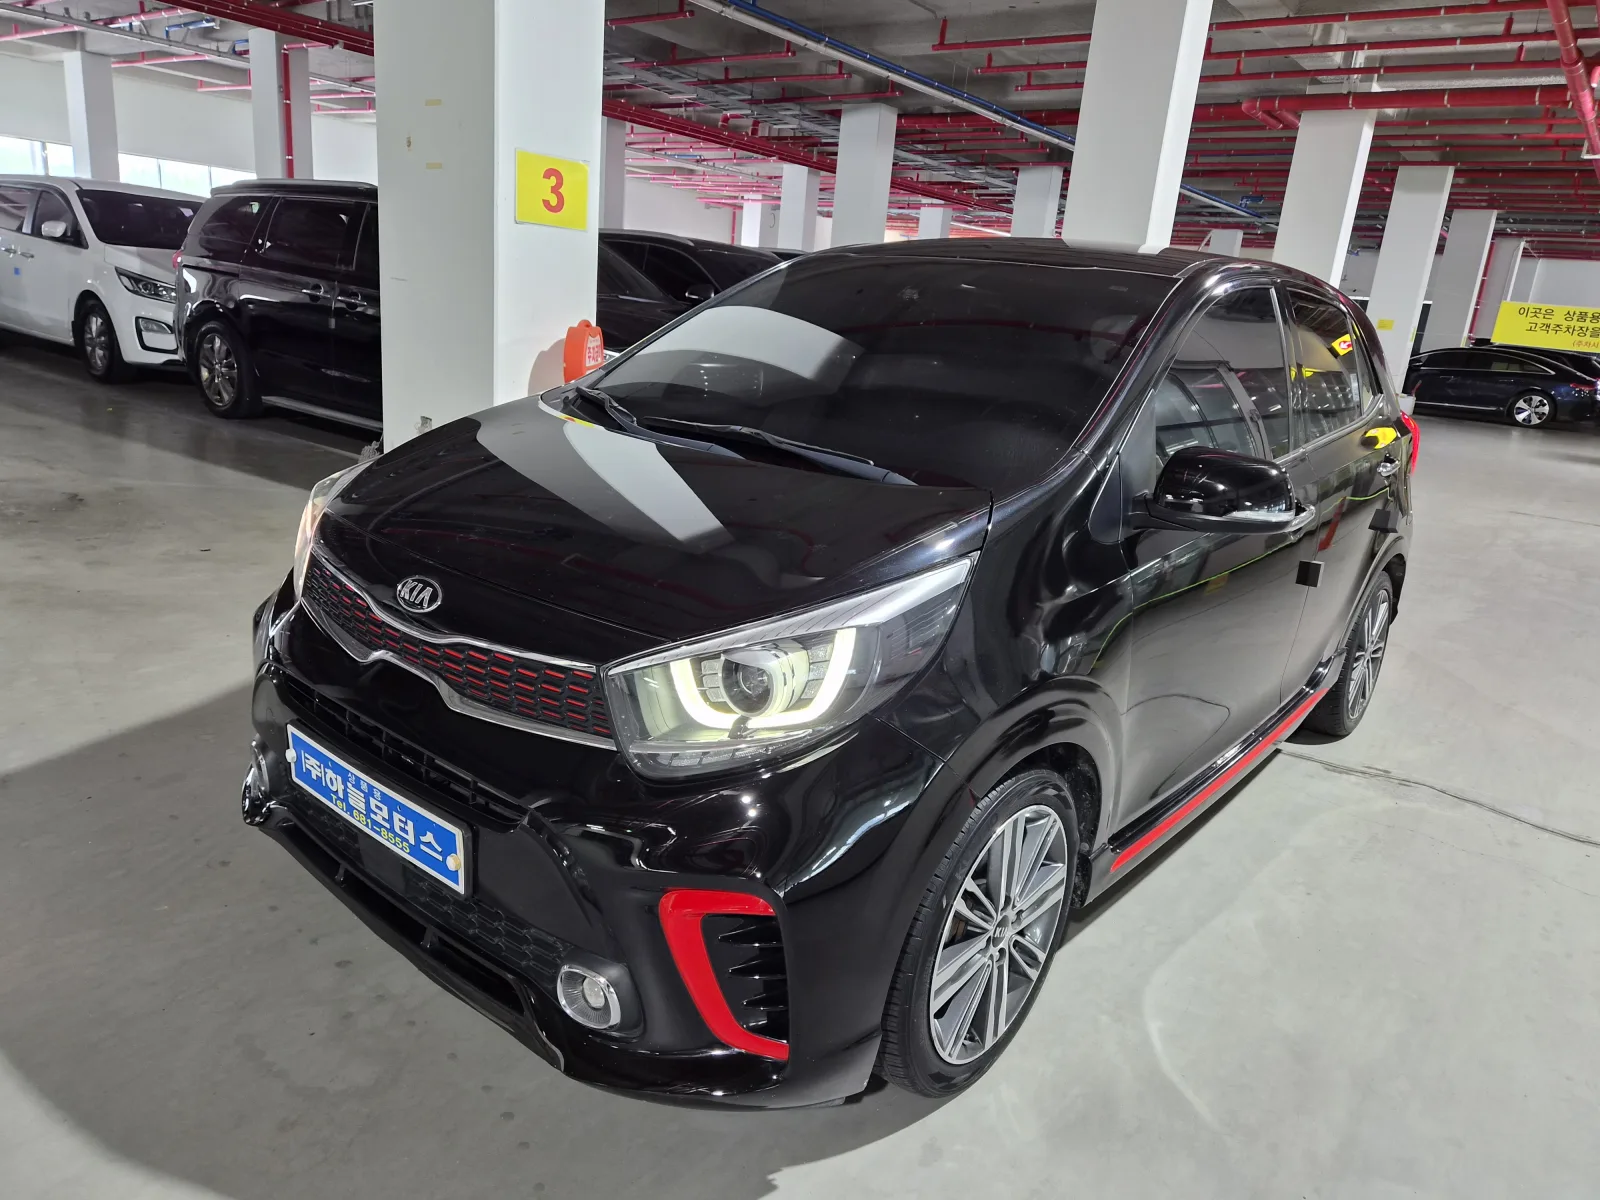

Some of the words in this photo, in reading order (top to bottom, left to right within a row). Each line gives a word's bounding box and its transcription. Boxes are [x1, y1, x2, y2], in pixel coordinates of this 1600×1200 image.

[541, 167, 565, 214] 3
[1518, 307, 1555, 320] 이곳은
[1563, 310, 1600, 324] 상품용
[1525, 322, 1600, 338] 고객주차장을
[399, 579, 434, 609] KIA
[330, 793, 351, 816] Tel.
[353, 810, 411, 854] 681-8555
